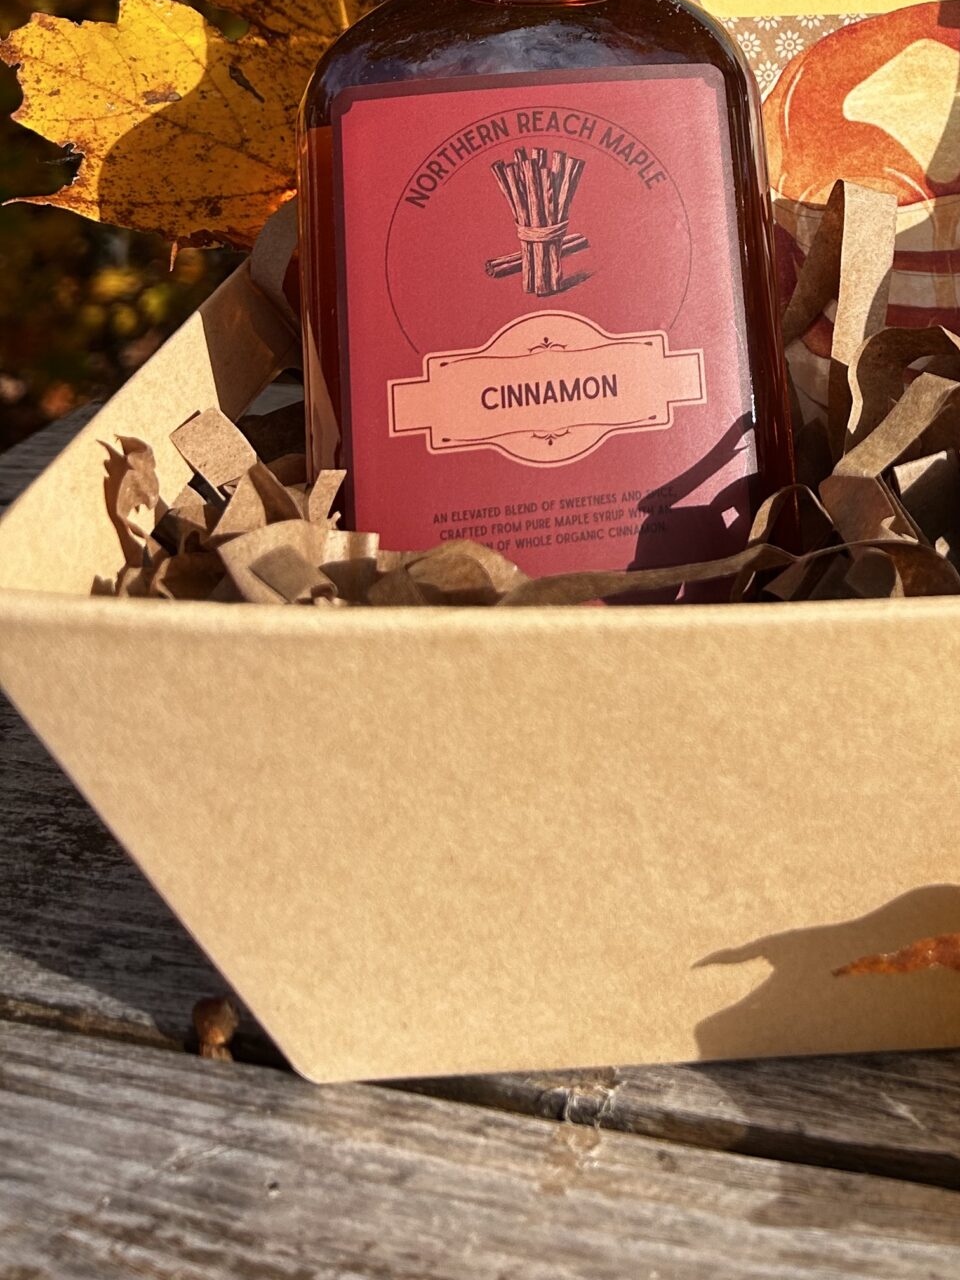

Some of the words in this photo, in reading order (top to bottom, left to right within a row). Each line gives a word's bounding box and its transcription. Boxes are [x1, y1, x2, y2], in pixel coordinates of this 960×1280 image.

[405, 119, 510, 208] NORTHERN
[516, 110, 598, 140] REACH
[599, 126, 667, 191] MAPLE
[480, 373, 618, 411] CINNAMON
[433, 512, 448, 524] AN
[451, 507, 501, 522] ELEVATED
[505, 502, 537, 516] BLEND
[541, 500, 556, 513] OF
[559, 493, 617, 509] SWEETNESS
[621, 489, 642, 504] AND
[439, 526, 487, 541] CRAFTED
[491, 521, 522, 536] FROM
[525, 518, 551, 532] PURE
[555, 513, 589, 528] MAPLE
[593, 509, 624, 524] SYRUP
[496, 539, 511, 552] OF
[515, 535, 552, 550] WHOLE
[555, 528, 605, 544] ORGANIC
